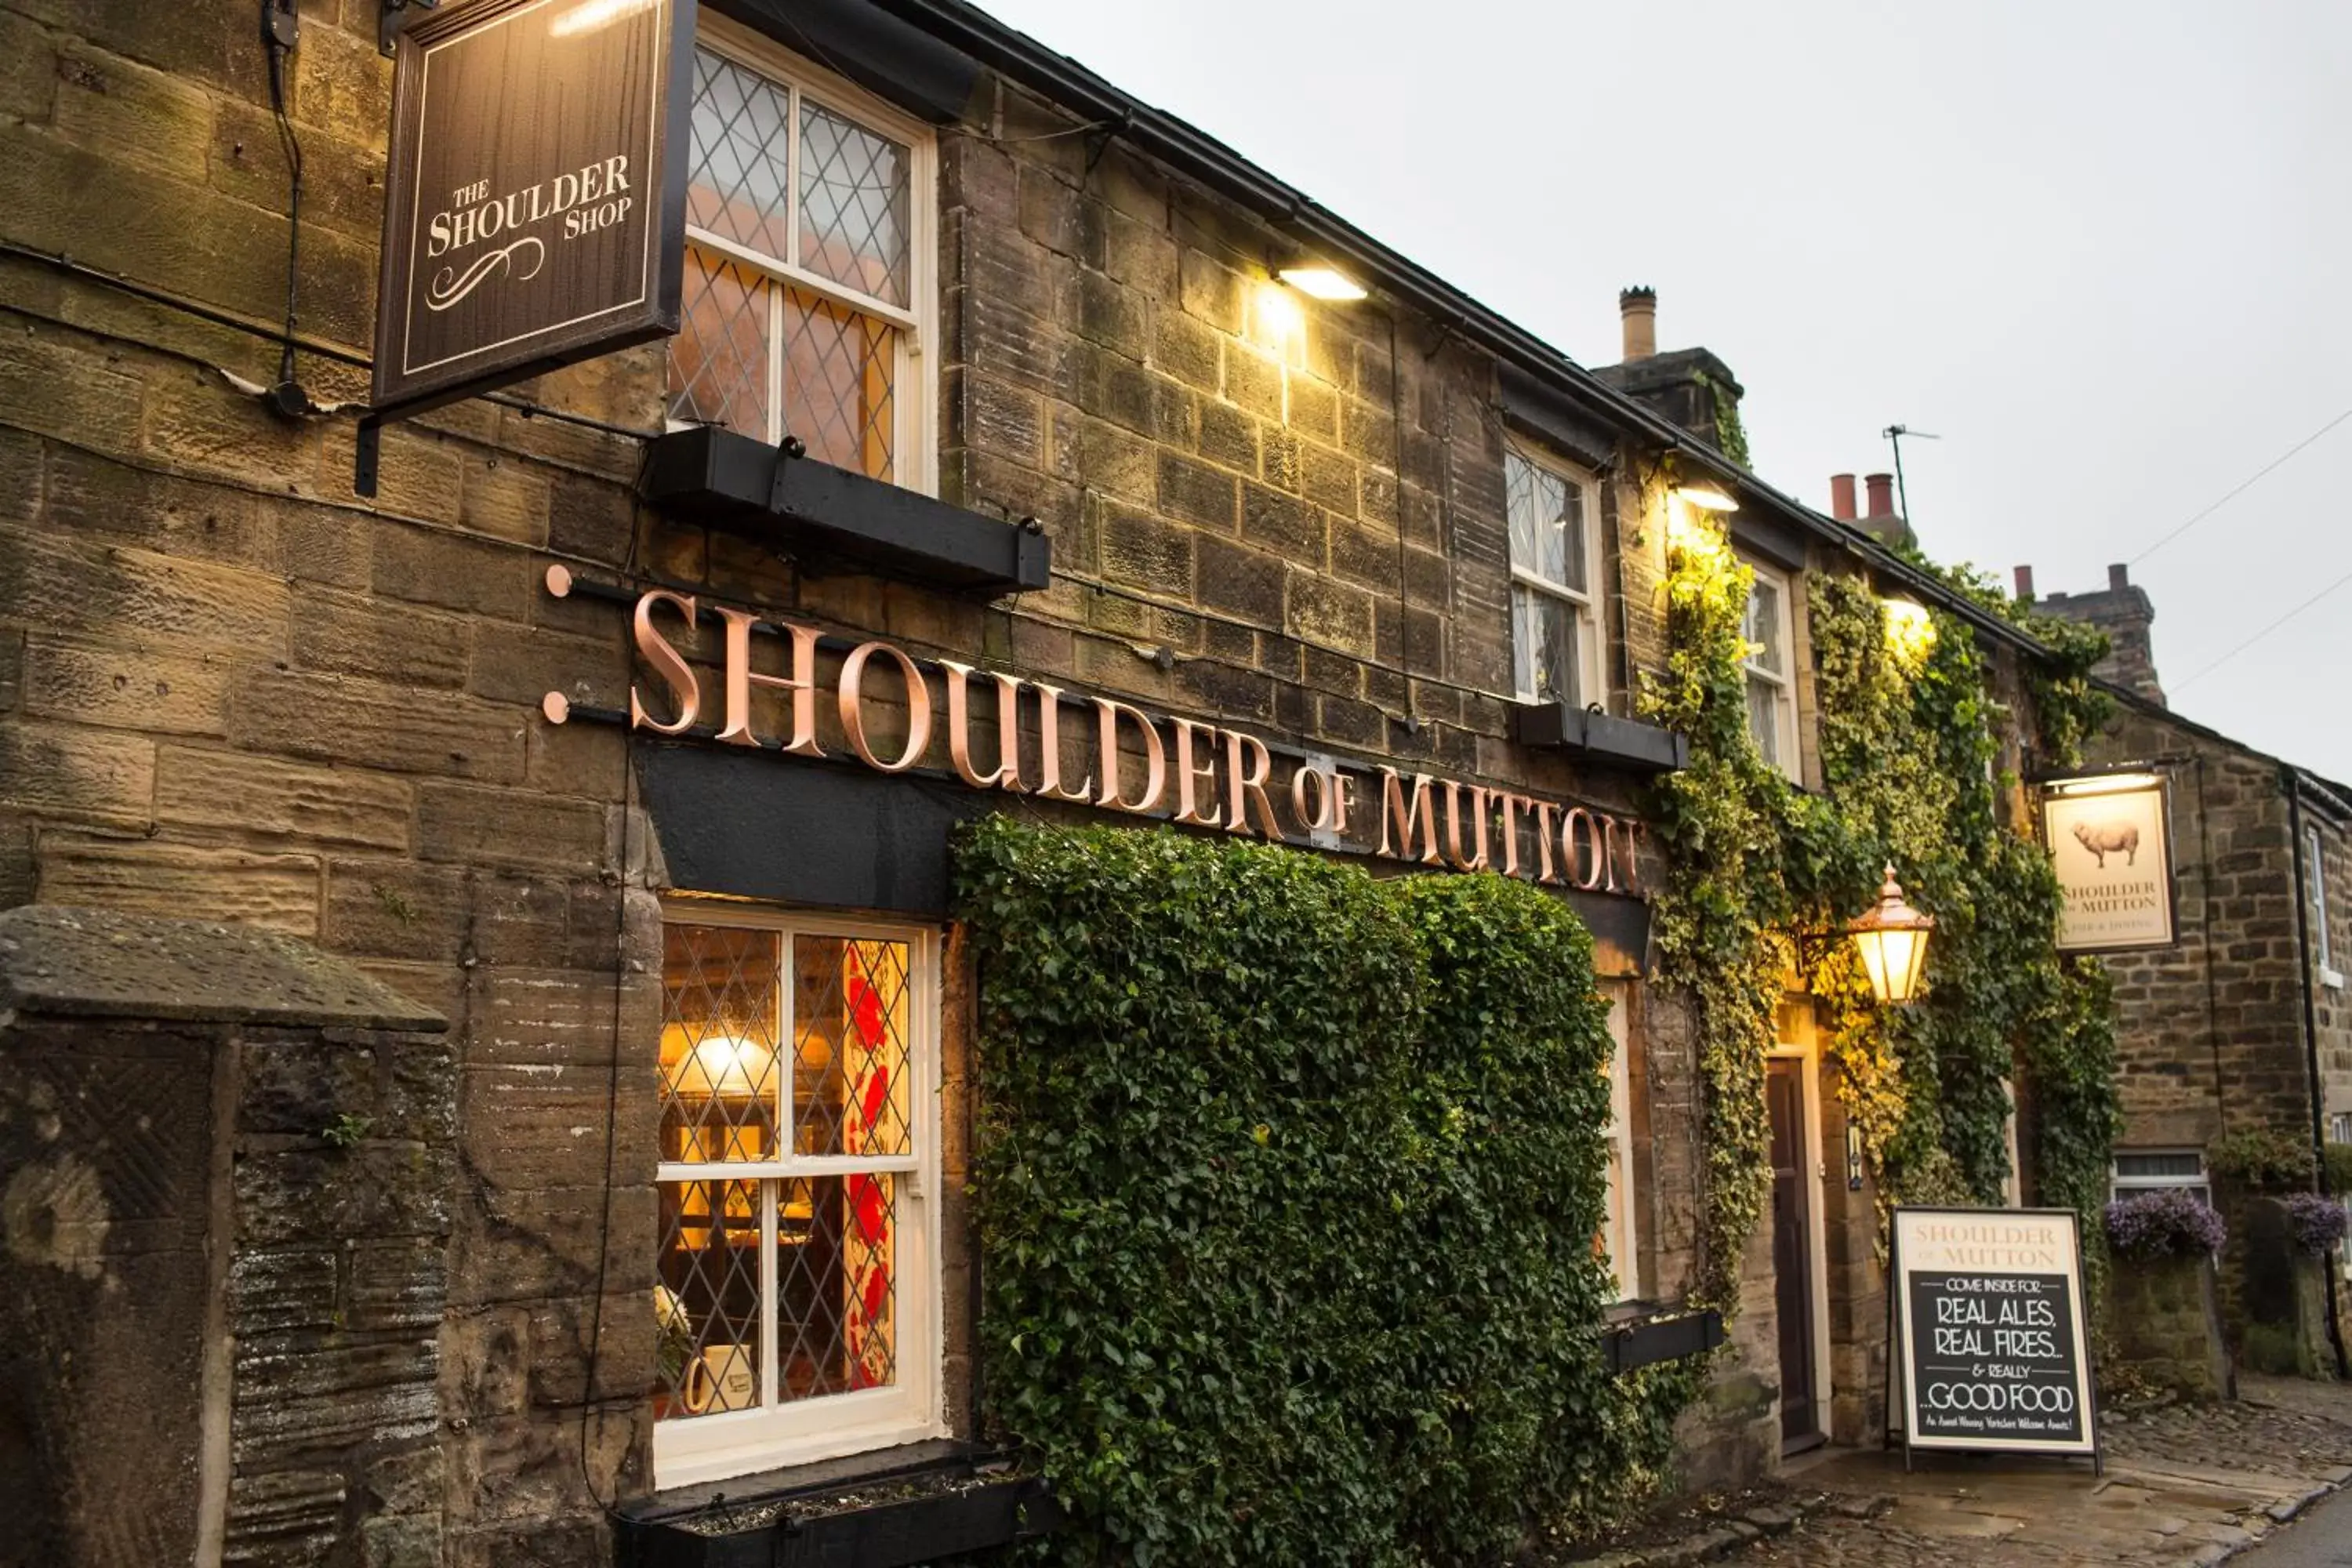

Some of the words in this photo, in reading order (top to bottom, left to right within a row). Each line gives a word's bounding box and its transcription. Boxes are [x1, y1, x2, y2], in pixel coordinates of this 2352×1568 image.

[428, 155, 630, 257] SHOULDER
[453, 179, 490, 208] THE
[564, 198, 632, 239] SHOP
[631, 590, 1284, 840] SHOULDER
[1292, 765, 1355, 835] OF
[1376, 764, 1645, 897] MUTTON
[2082, 895, 2156, 914] MUTTON
[1915, 1225, 2056, 1245] SHOULDER
[1944, 1247, 2056, 1267] MUTTON
[1945, 1277, 1983, 1293] COME
[1984, 1279, 2017, 1293] INSIDE
[1936, 1297, 1995, 1324] REAL
[1999, 1298, 2056, 1328] ALES,
[1934, 1327, 1991, 1356] REAL
[1972, 1363, 1985, 1377] &
[1988, 1363, 2031, 1378] REALLY
[2009, 1384, 2074, 1413] FOOD
